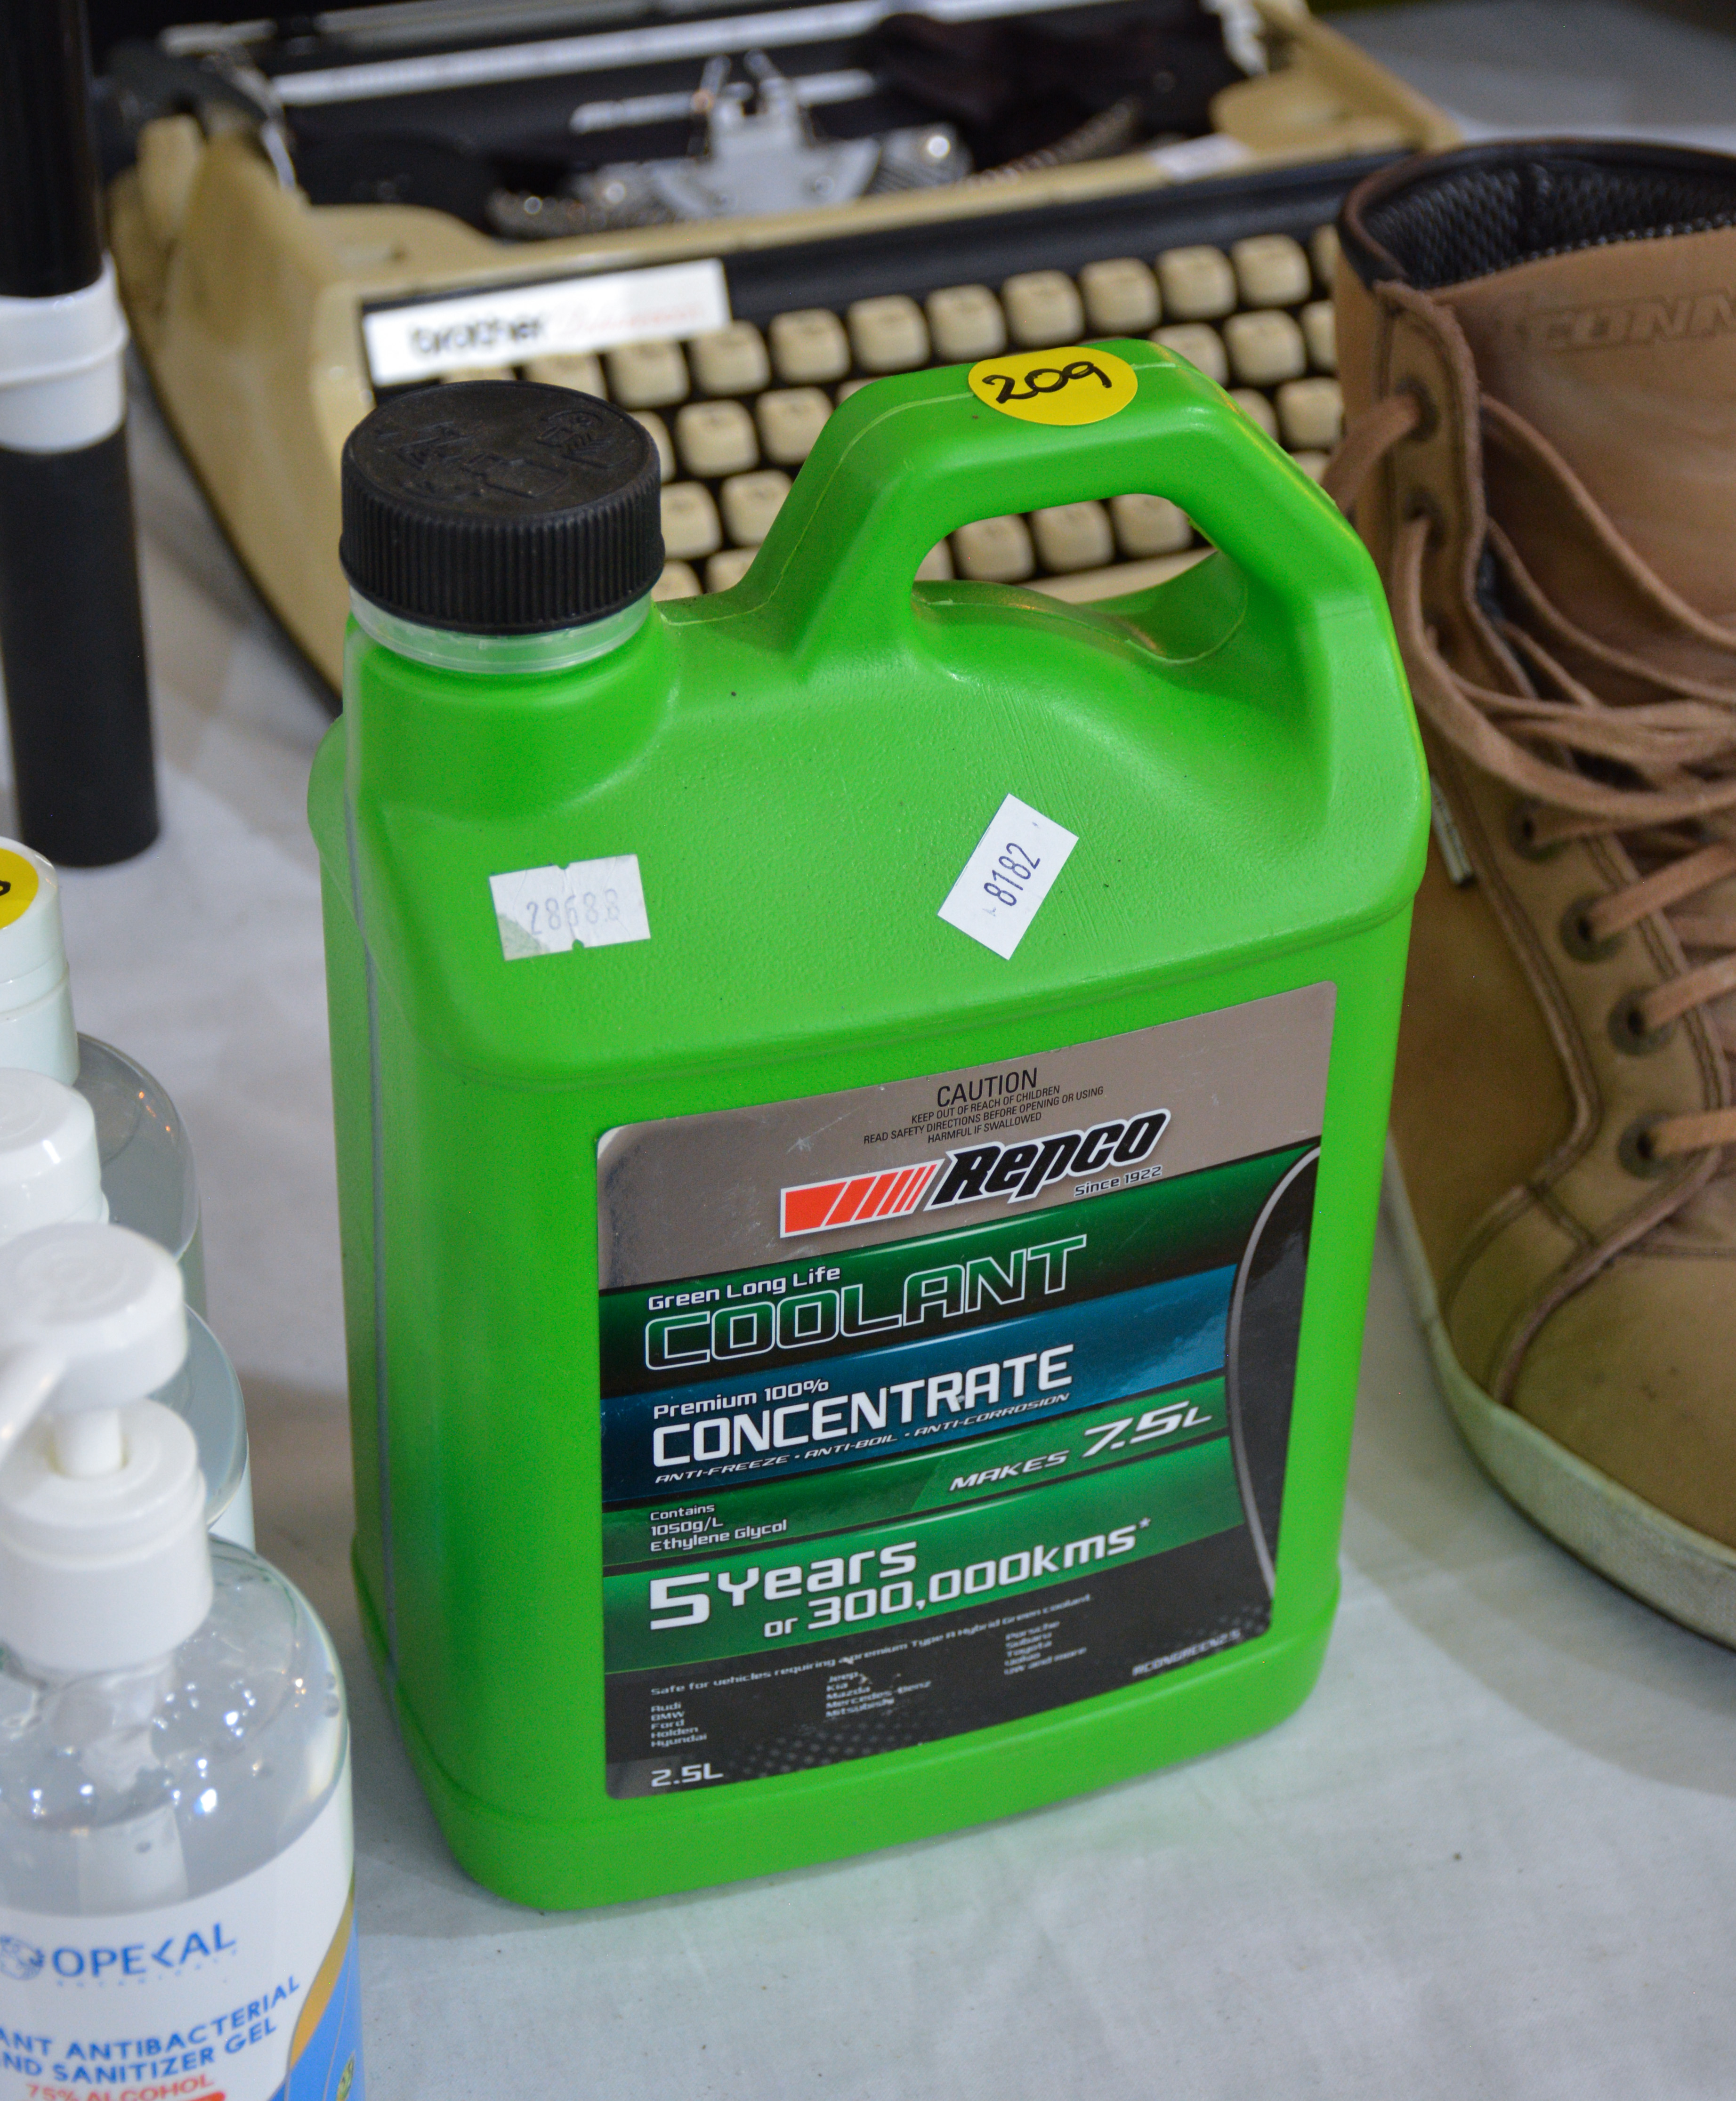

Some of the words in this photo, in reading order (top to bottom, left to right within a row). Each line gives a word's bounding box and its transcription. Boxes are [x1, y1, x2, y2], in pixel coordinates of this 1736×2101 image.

[982, 361, 1112, 404] 209
[984, 843, 1040, 906] 8182
[937, 1067, 1037, 1107] CAUTION
[864, 1132, 888, 1144] READ
[891, 1126, 924, 1139] SAFETY
[927, 1114, 980, 1132] DIRECTIONS
[984, 1106, 1017, 1121] BEFORE
[1019, 1097, 1059, 1113] OPENING
[1062, 1093, 1074, 1103] OR
[1076, 1086, 1103, 1100] USING
[912, 1111, 934, 1124] KEEP
[937, 1108, 955, 1119] OUT
[958, 1104, 969, 1115] OF
[970, 1098, 1000, 1112] REACH
[1003, 1095, 1015, 1105] OF
[1017, 1085, 1060, 1103] CHILDREN
[928, 1128, 971, 1143] HARMFUL
[974, 1125, 982, 1134] IF
[984, 1112, 1042, 1132] SWALLOWED
[925, 1109, 1171, 1210] Repco
[1074, 1176, 1120, 1197] Since
[1123, 1165, 1163, 1184] 1922
[646, 1234, 1087, 1370] COOLANT
[648, 1288, 719, 1311] Green
[727, 1278, 786, 1298] Long
[793, 1266, 840, 1288] Life
[653, 1344, 1074, 1468] CONCENTRATE
[654, 1394, 757, 1419] Premium
[764, 1379, 829, 1401] 100%
[655, 1455, 790, 1483] ANTI-FREEZE
[804, 1433, 897, 1458] ANTI-BOIL
[914, 1392, 1070, 1436] ANTI-CORROSION
[949, 1450, 1070, 1491] MAKES
[1081, 1400, 1213, 1458] 7.5L
[650, 1505, 715, 1521] Contains
[651, 1517, 723, 1536] 1050g/L
[650, 1531, 729, 1552] Ethylene
[735, 1519, 787, 1539] Glycol
[650, 1572, 710, 1630] 5
[718, 1541, 917, 1607] Years
[764, 1618, 799, 1638] or
[1005, 1621, 1060, 1641] Porsche
[1006, 1632, 1052, 1649] Subaru
[651, 1684, 685, 1695] Safe
[689, 1682, 710, 1690] for
[713, 1671, 771, 1686] vehicles
[775, 1659, 836, 1676] requiring
[849, 1643, 908, 1662] premium
[911, 1634, 944, 1647] Type
[957, 1618, 1000, 1636] Hybrid
[1002, 1609, 1041, 1625] Green
[1007, 1640, 1052, 1658] Toyota
[826, 1683, 848, 1692] Kia
[829, 1671, 859, 1683] Jeep
[651, 1702, 682, 1712] Audi
[825, 1697, 895, 1717] Mitsubishi
[826, 1686, 871, 1700] Mazda
[651, 1711, 685, 1722] BMW
[651, 1719, 685, 1730] Ford
[651, 1726, 699, 1739] Holden
[651, 1733, 707, 1747] Hyundai
[651, 1763, 724, 1787] 2.5L
[66, 1975, 300, 2061] ANTIBACTERIAL
[53, 2047, 215, 2085] SANITIZER
[225, 2017, 277, 2055] GEL
[87, 2073, 215, 2101] ALCOHOL
